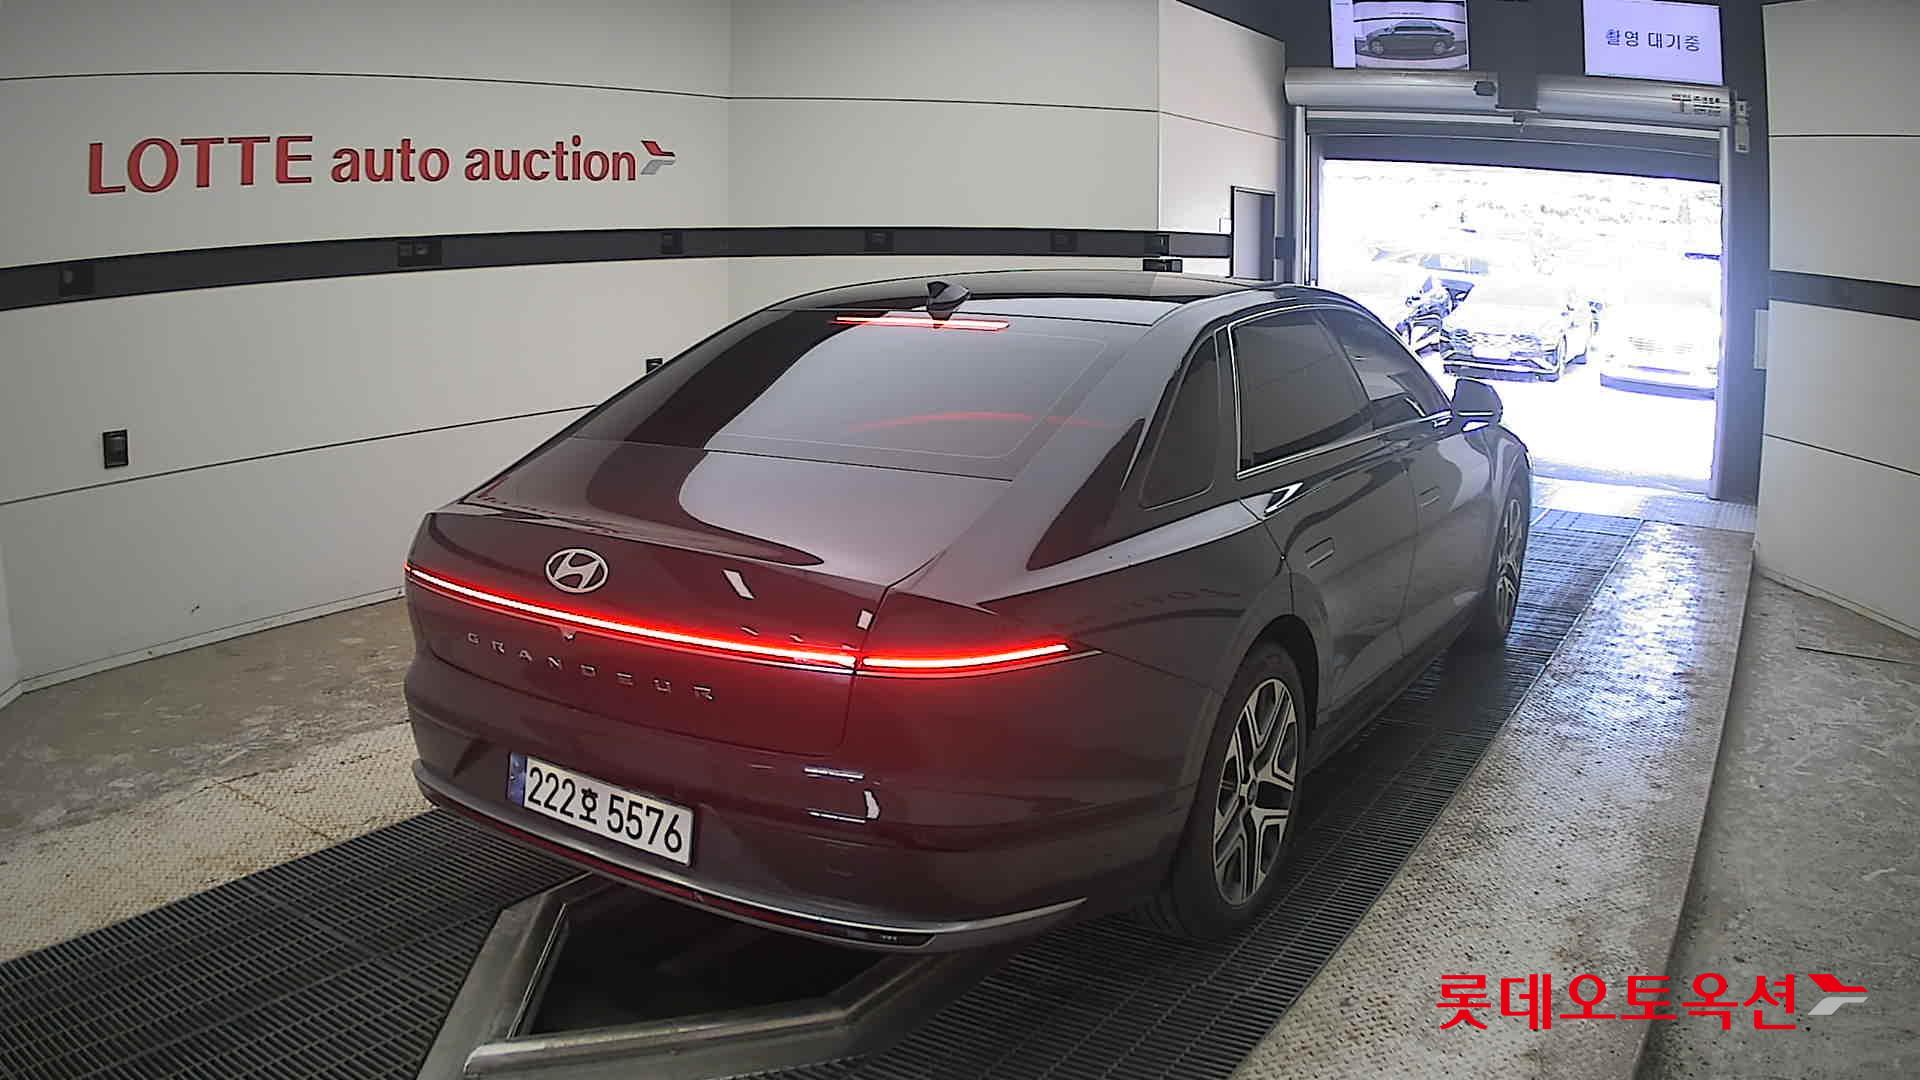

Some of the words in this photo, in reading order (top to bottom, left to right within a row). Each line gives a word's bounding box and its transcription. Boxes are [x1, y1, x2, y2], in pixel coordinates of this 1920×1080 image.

[1606, 28, 1639, 48] 촬영
[1647, 31, 1701, 52] 대기중
[89, 135, 313, 194] LOTTE
[331, 138, 450, 183] auto
[463, 134, 638, 182] auction
[467, 632, 713, 700] GRANDEUR
[528, 766, 598, 825] 222호
[606, 793, 682, 853] 5576
